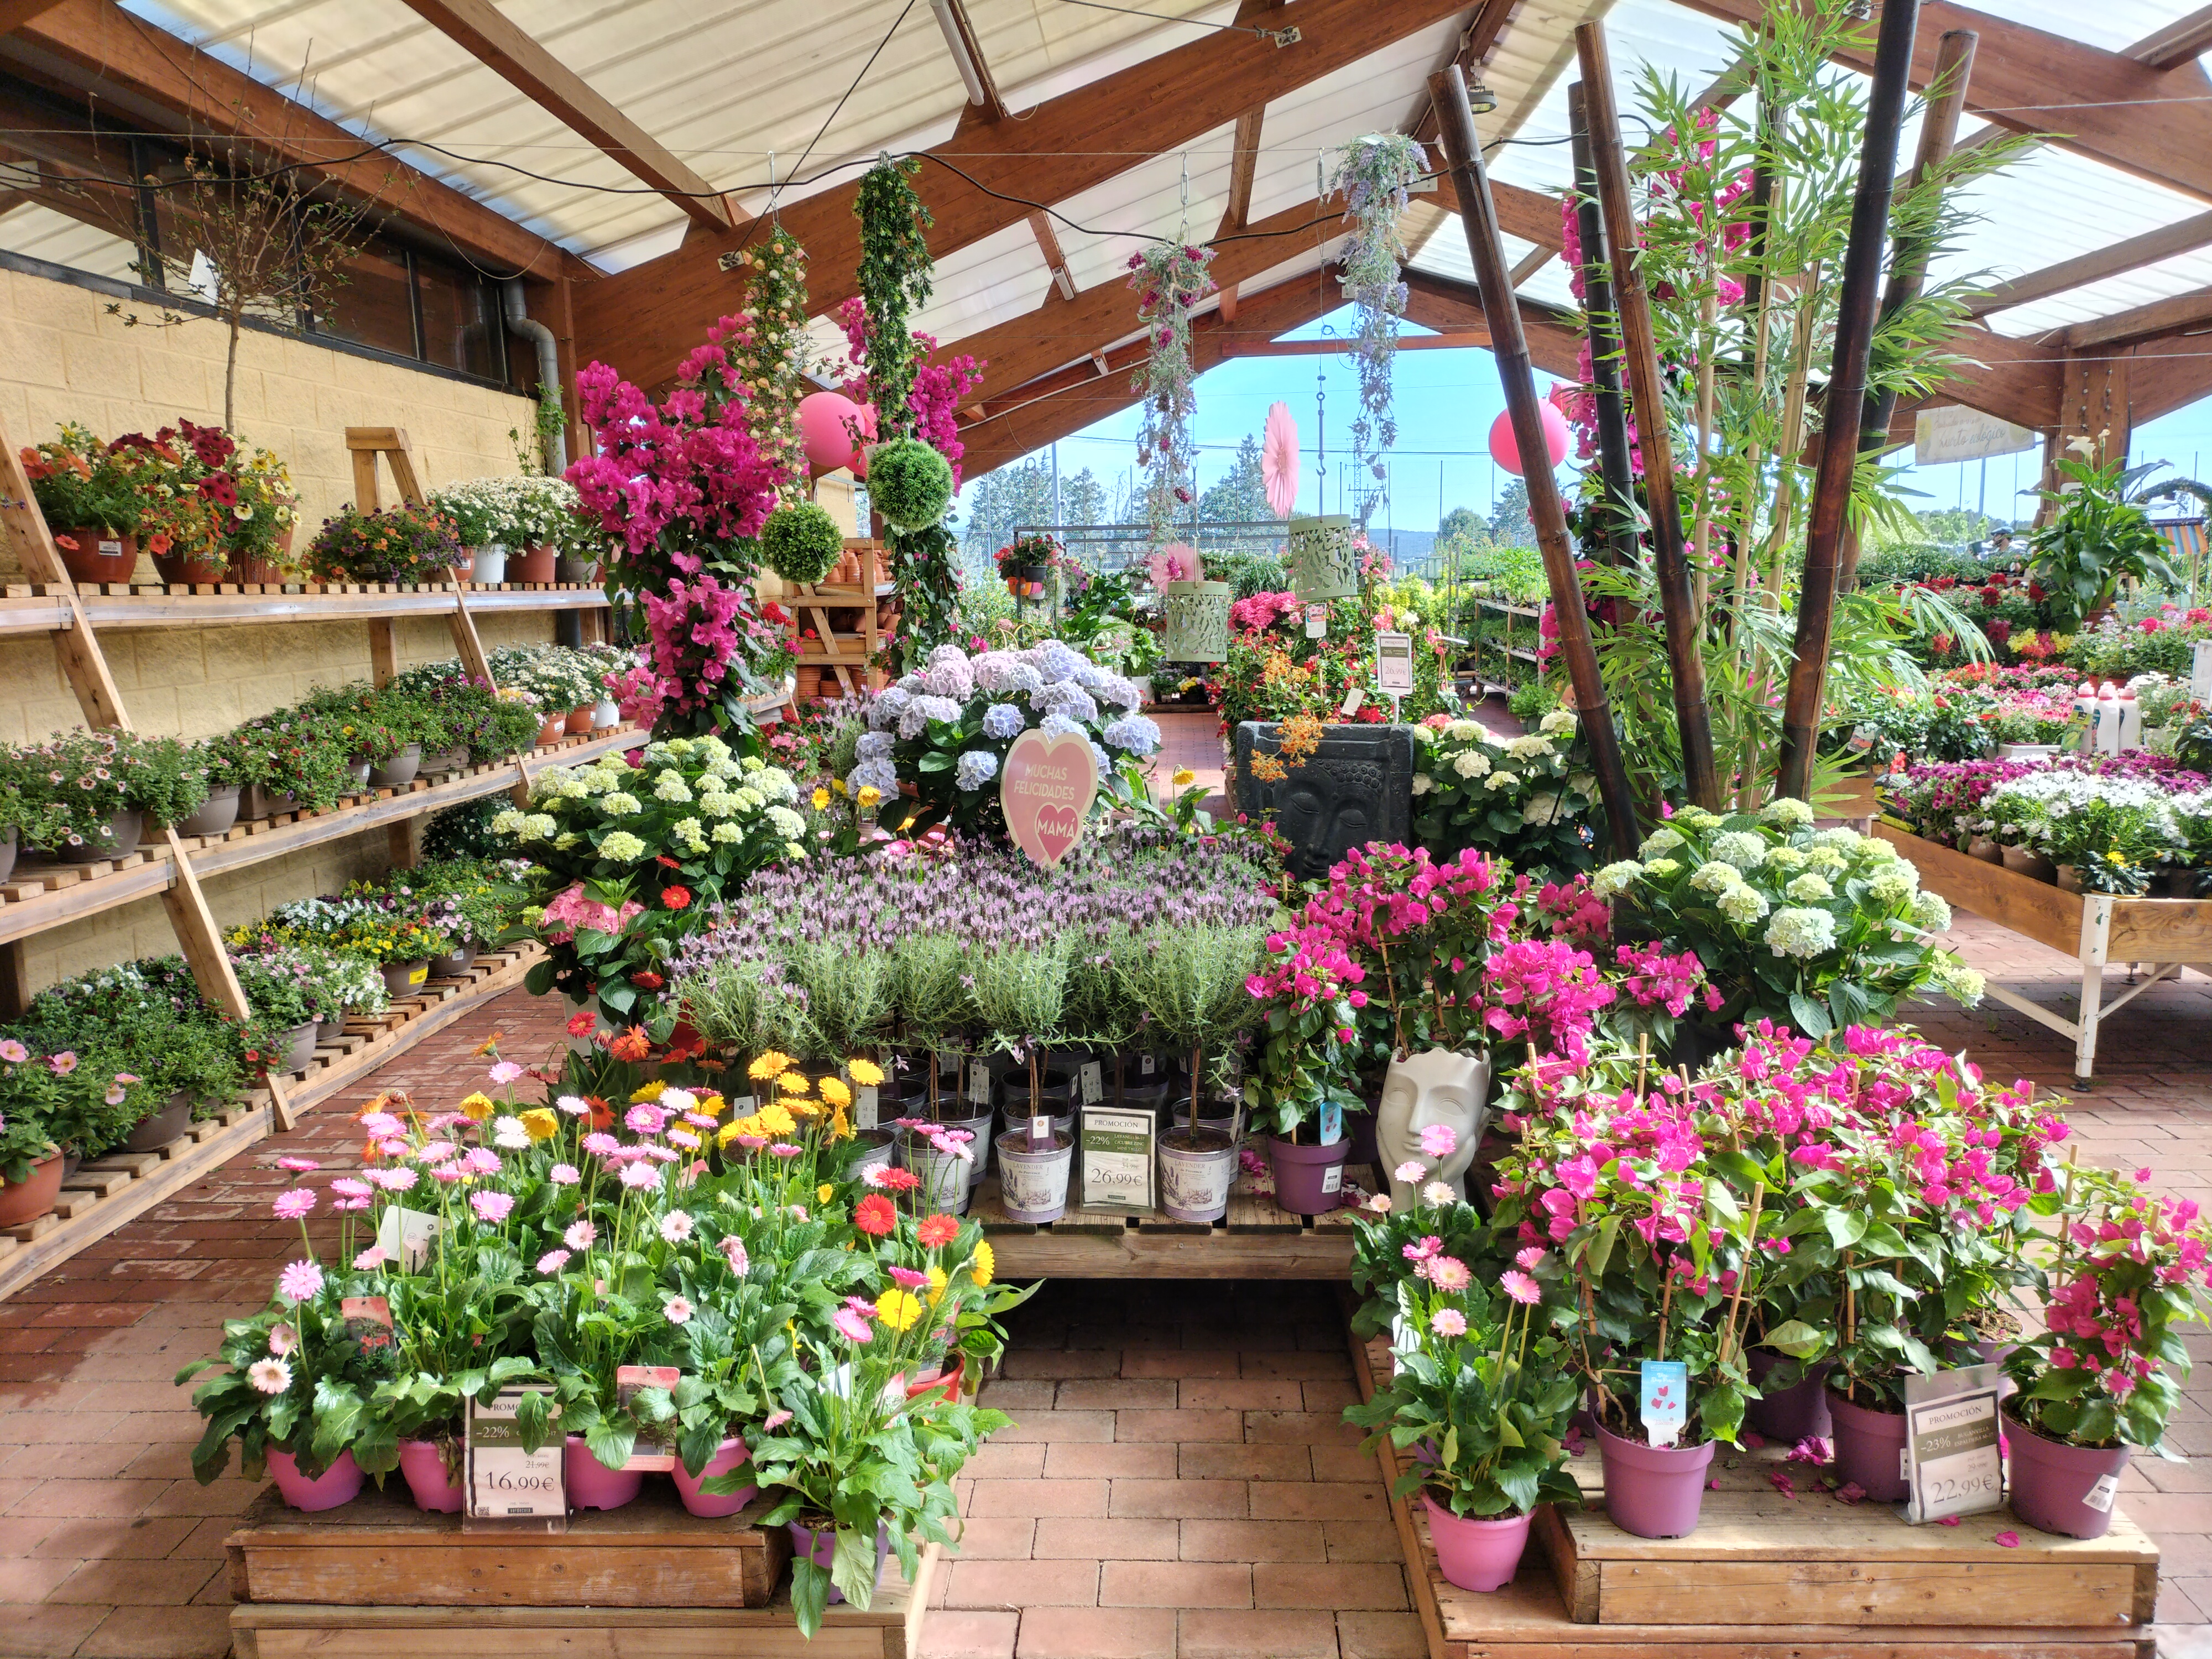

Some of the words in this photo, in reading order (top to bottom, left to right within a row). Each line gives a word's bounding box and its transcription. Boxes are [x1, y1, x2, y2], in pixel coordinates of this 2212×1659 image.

[1025, 763, 1067, 781] MUCHAS
[1014, 780, 1075, 801] FELICIDADES
[1037, 817, 1076, 838] MAMÁ
[1094, 1119, 1139, 1128] PROMOCIÓN
[1086, 1135, 1110, 1146] -22%
[1013, 1162, 1044, 1170] LAVENDER
[1175, 1160, 1206, 1168] LAVENDER
[1091, 1168, 1142, 1186] 26,99€
[1928, 1405, 1983, 1425] PROMOCIÓN
[476, 1426, 510, 1438] -22%
[1920, 1435, 1951, 1452] -23%
[485, 1471, 555, 1491] 16,99€
[1931, 1474, 1994, 1504] 22,99€
